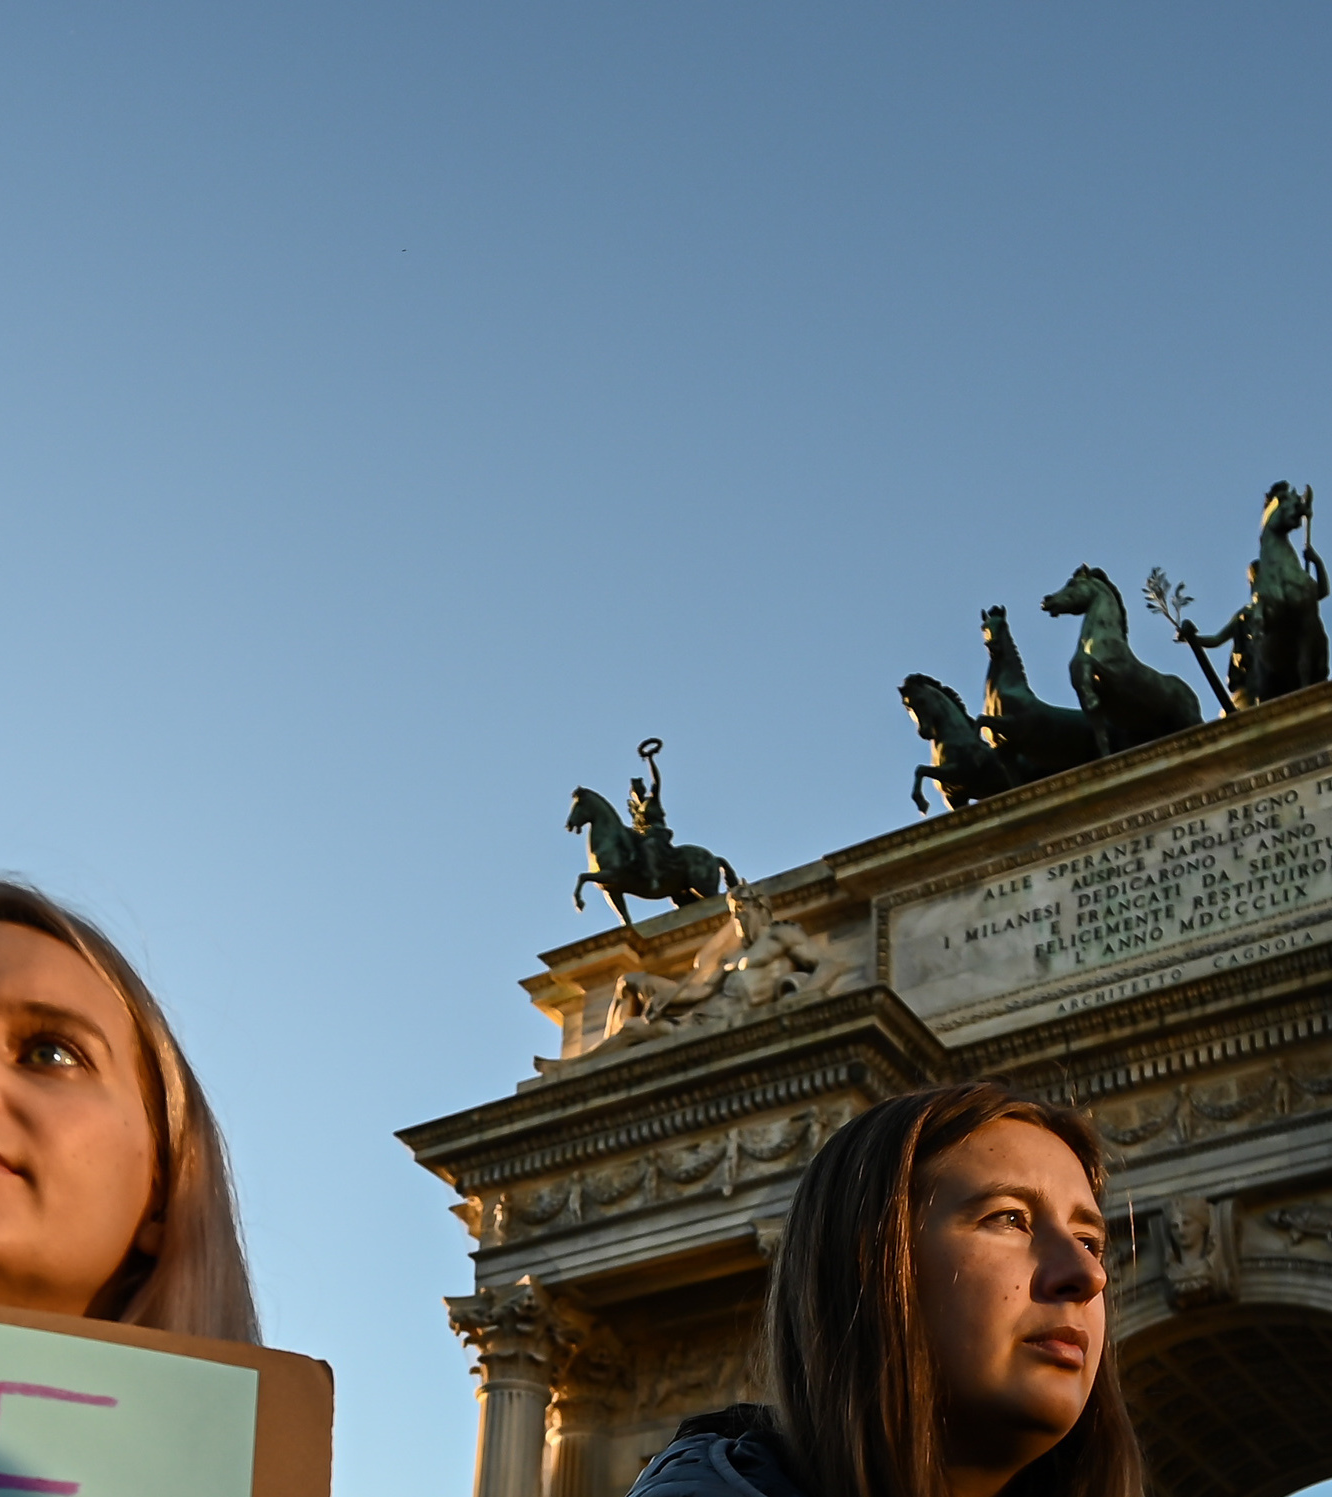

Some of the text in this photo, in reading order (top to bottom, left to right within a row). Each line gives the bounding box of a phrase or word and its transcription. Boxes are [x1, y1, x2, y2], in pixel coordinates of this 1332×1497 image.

[943, 936, 950, 949] I
[965, 901, 1061, 943] MILANESI
[1078, 854, 1216, 908] DEDICARONO
[1257, 823, 1316, 852] ANNO
[984, 875, 1032, 901] ALLE
[1047, 834, 1156, 882] SPERANZE
[1172, 819, 1210, 841] DEL
[1227, 790, 1298, 823] REGNO
[1071, 805, 1305, 892] AUSPICE NAPOLEONE I
[1034, 904, 1175, 958] FELICEMENTE
[1051, 921, 1060, 935] E
[1076, 883, 1181, 926] FRANCATI
[1202, 869, 1230, 889] DA
[1102, 927, 1163, 956] ANNO
[1180, 885, 1308, 934] MDCCCLIX
[1057, 932, 1313, 1013] ARCHITETTO CAGNOLA
